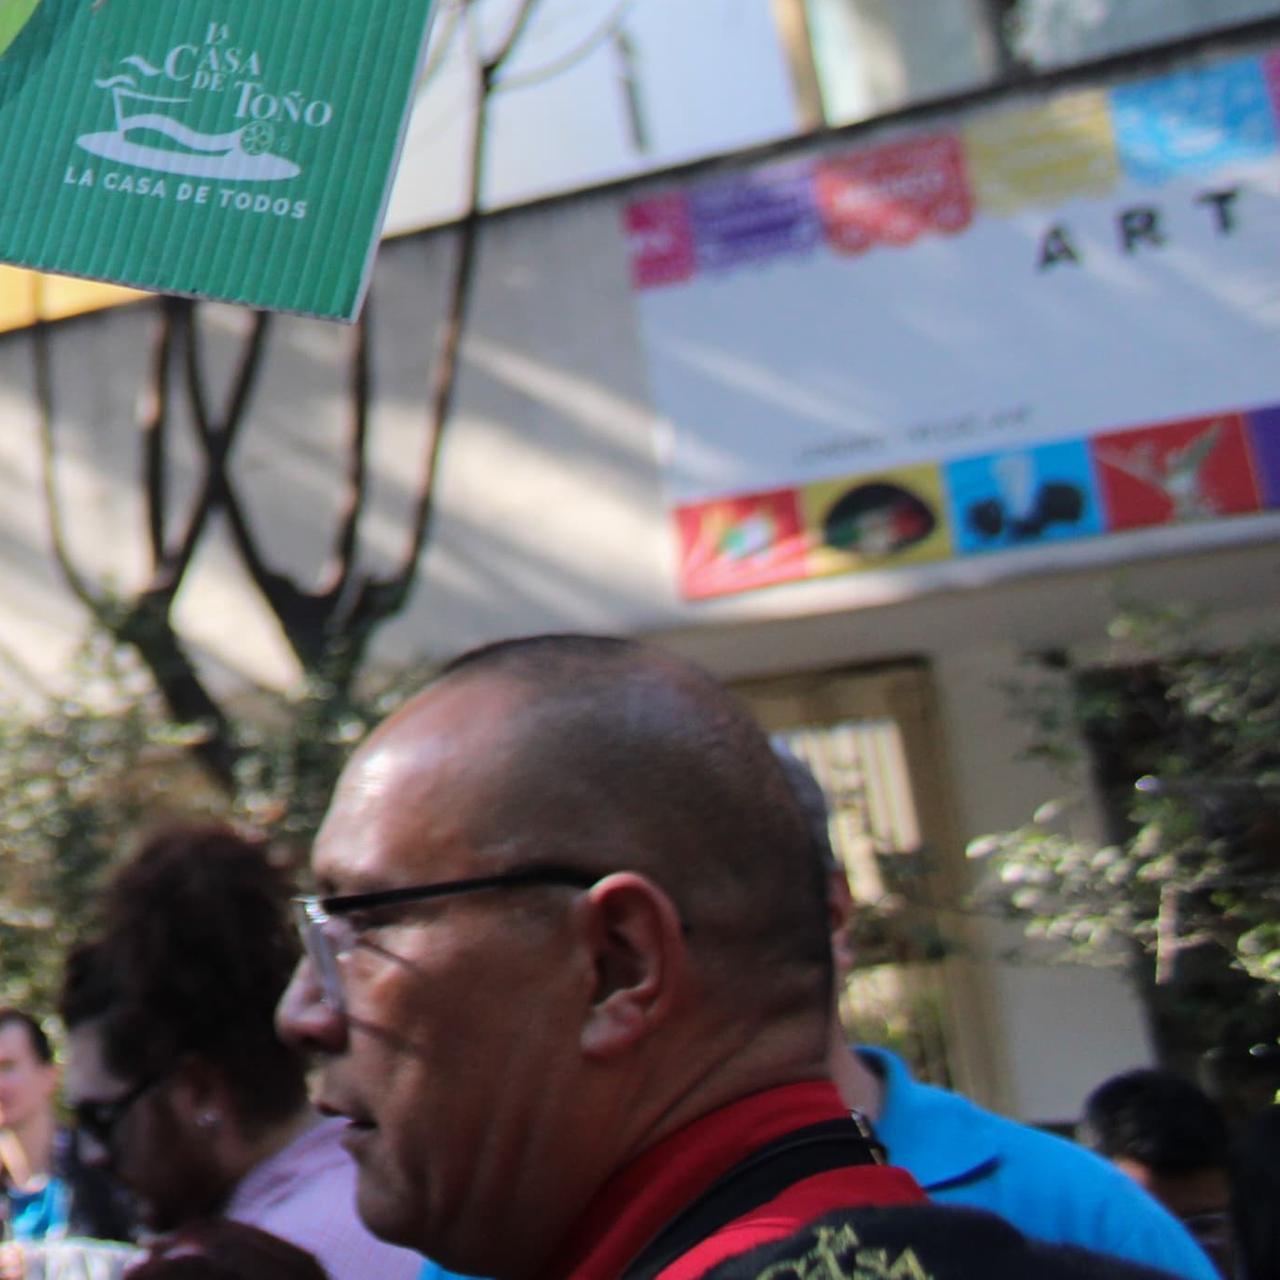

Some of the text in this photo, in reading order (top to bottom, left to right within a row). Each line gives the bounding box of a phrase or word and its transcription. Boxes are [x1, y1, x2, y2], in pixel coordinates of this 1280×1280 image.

[205, 22, 230, 45] LA
[164, 43, 262, 81] CASA
[192, 70, 225, 92] DE
[234, 81, 333, 128] TOÑO
[63, 166, 308, 219] LA CASA DE TODOS
